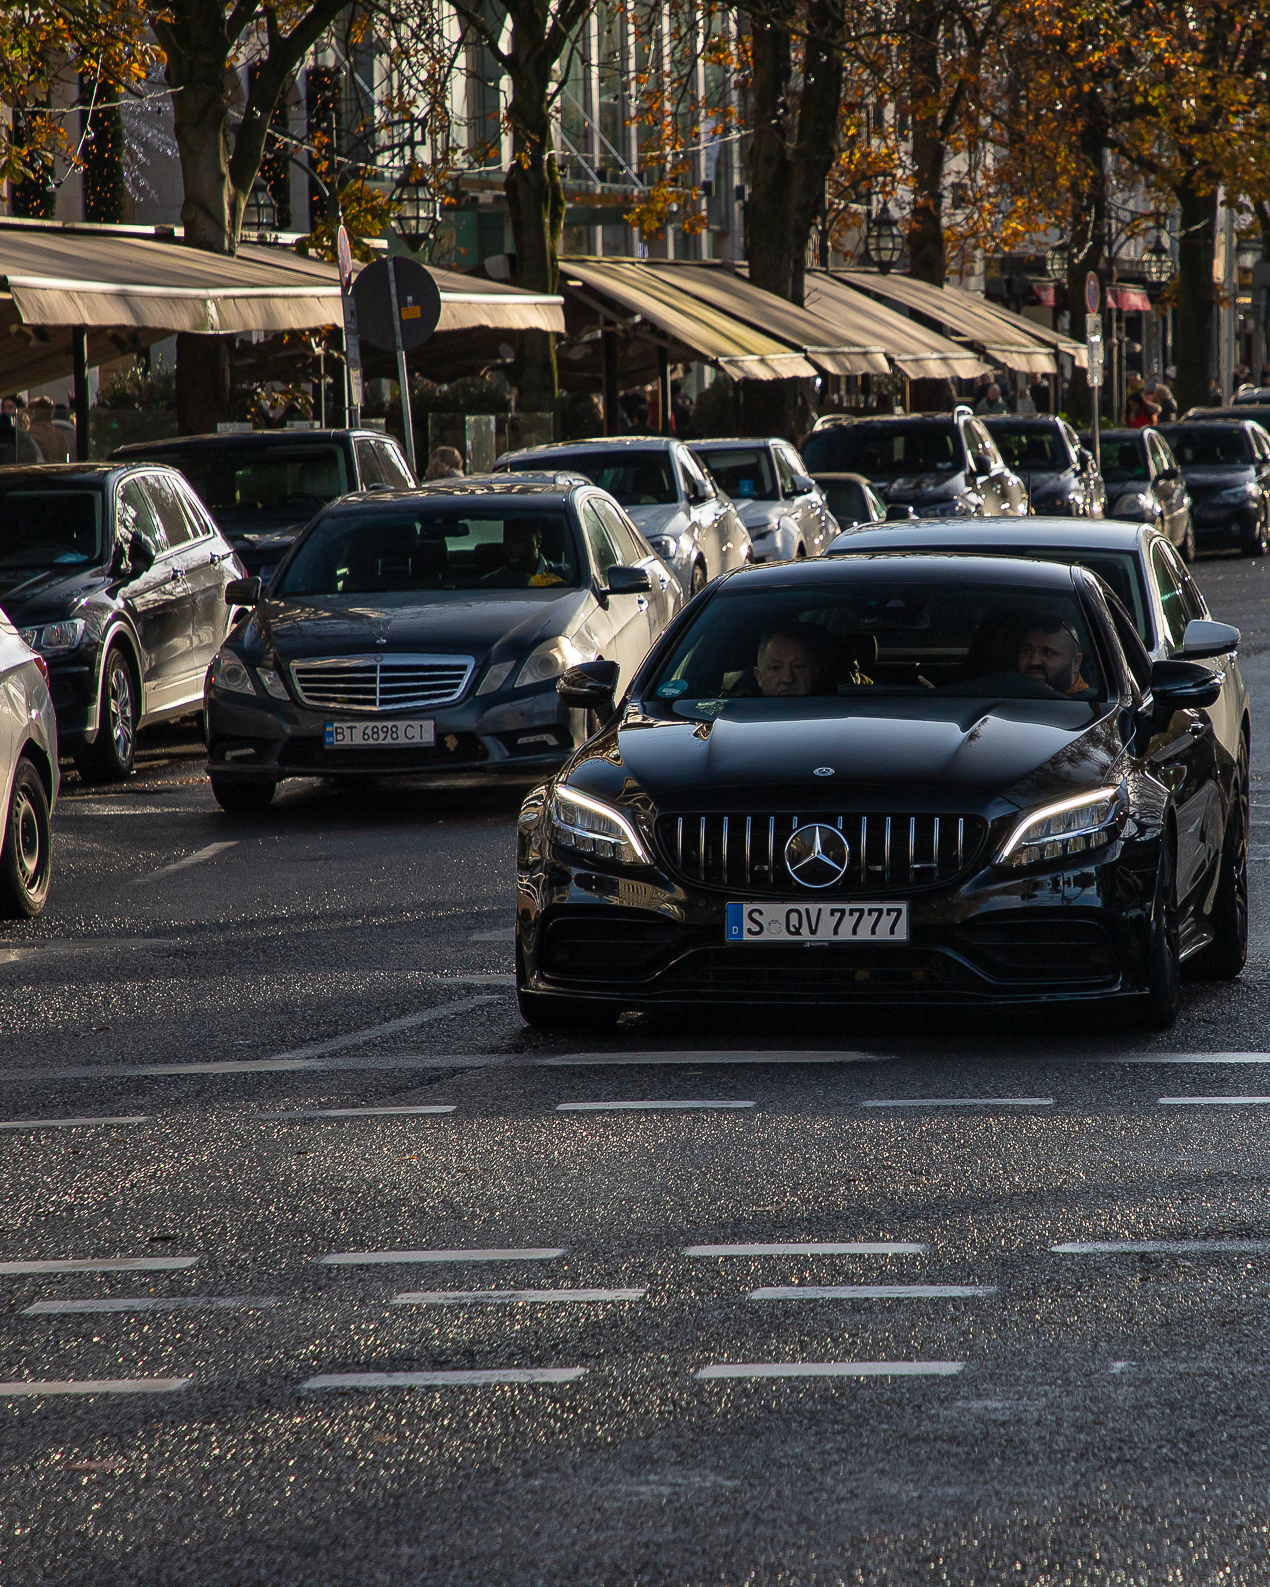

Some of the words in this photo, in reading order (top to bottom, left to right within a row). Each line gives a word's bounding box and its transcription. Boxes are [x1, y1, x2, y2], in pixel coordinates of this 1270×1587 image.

[335, 726, 357, 743] BT
[361, 724, 399, 741] 6898
[404, 724, 423, 740] CI
[732, 926, 738, 935] D
[746, 908, 765, 936] S
[785, 907, 823, 936] QV
[829, 908, 903, 936] 7777
